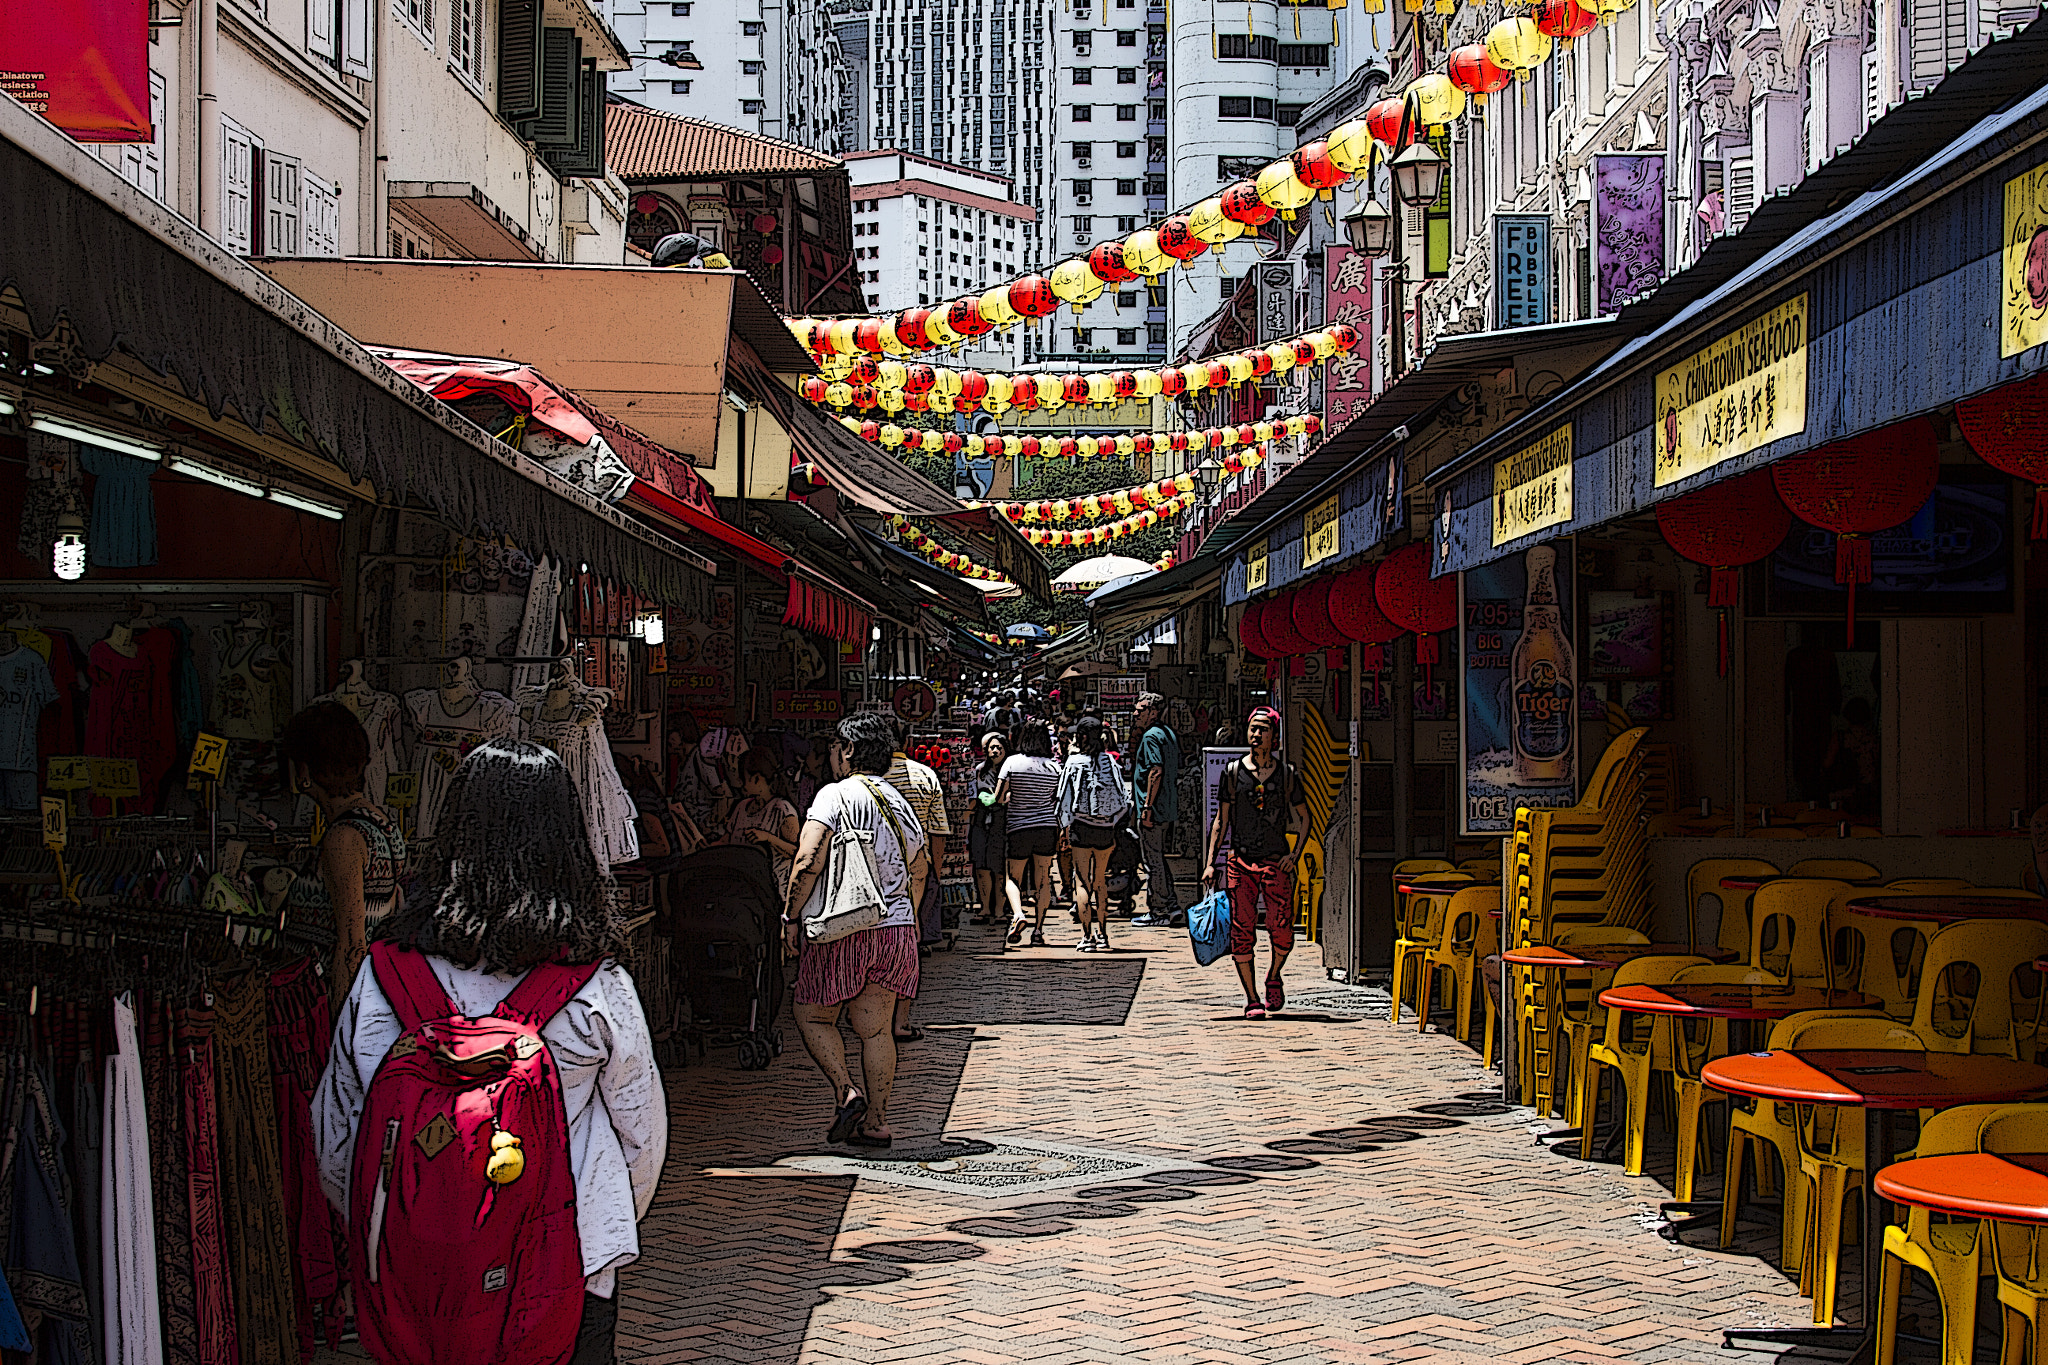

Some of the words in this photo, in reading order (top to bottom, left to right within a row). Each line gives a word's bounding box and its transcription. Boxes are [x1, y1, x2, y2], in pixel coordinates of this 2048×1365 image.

[1527, 227, 1538, 324] BUBBLE
[1686, 342, 1746, 406] CHINATOWN
[1748, 314, 1800, 376] SEAFOOD
[1478, 634, 1501, 650] BIG
[1470, 654, 1510, 669] BOTTLE
[689, 674, 715, 690] $10
[776, 701, 785, 713] 3
[790, 700, 809, 713] for
[813, 700, 837, 714] $10
[901, 692, 923, 716] $1
[1518, 691, 1570, 720] Tiger
[1470, 796, 1508, 821] ICE
